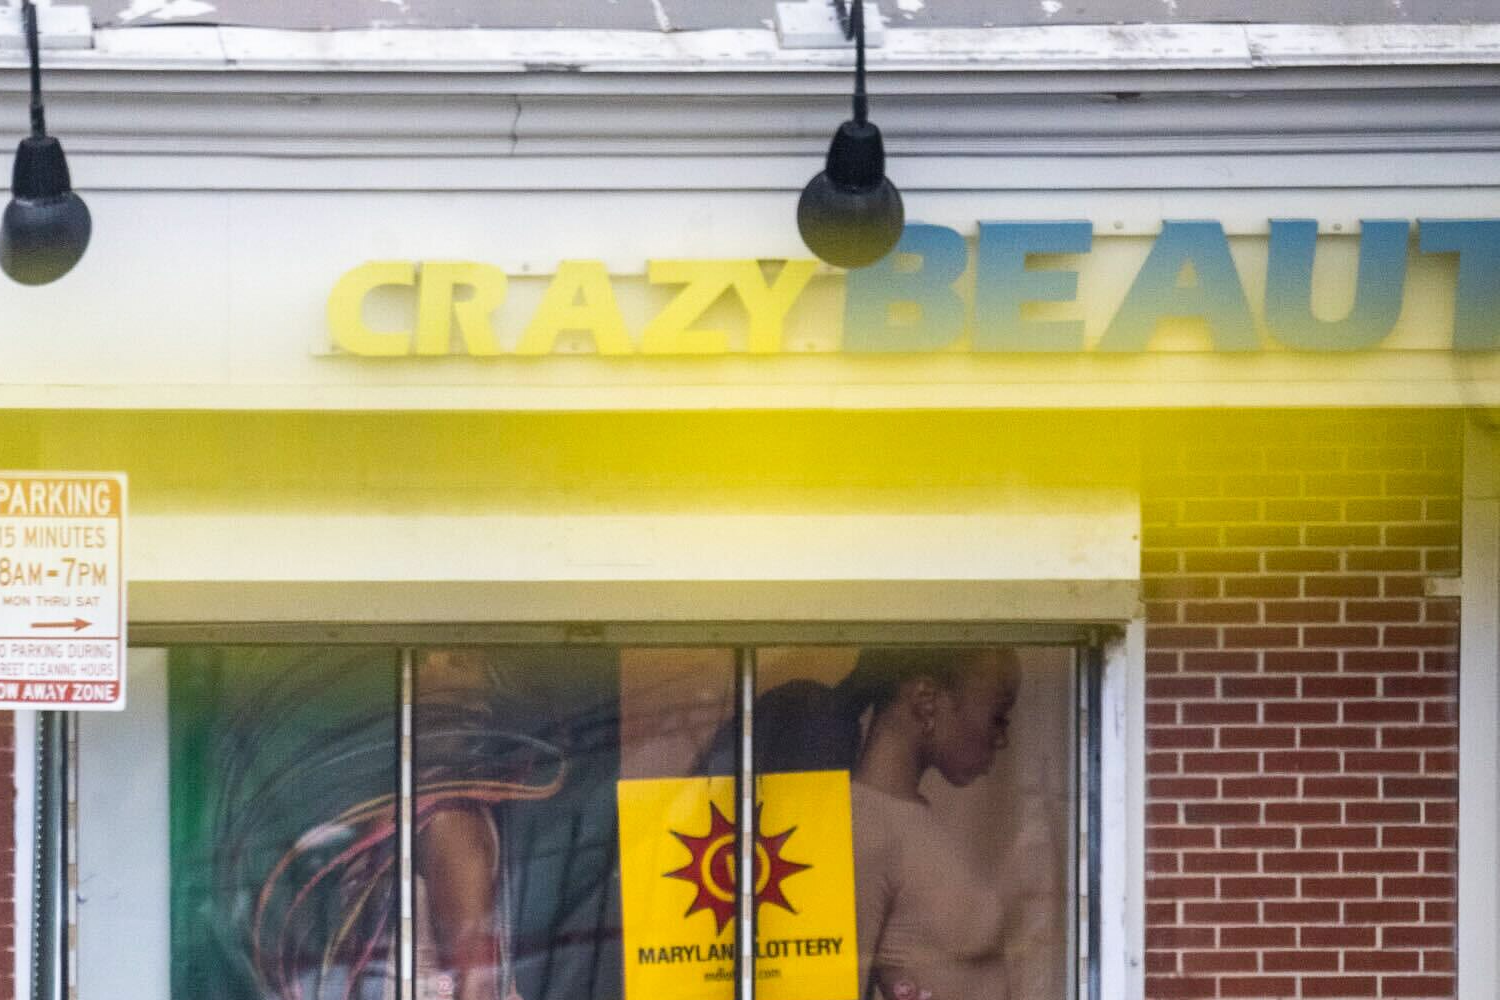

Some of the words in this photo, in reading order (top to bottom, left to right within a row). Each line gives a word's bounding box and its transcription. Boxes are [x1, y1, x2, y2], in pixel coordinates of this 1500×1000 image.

[324, 258, 820, 357] CRAZY
[24, 526, 107, 549] MINUTES
[3, 595, 31, 607] MON
[36, 595, 70, 607] THRU
[76, 595, 100, 607] SAT
[10, 643, 63, 658] PARKING
[67, 643, 112, 658] DURING
[28, 662, 78, 676] CLEANING
[80, 662, 114, 676] HOURS
[23, 683, 68, 700] AWAY
[71, 683, 116, 702] ZONE
[638, 944, 735, 964] MARYLAN
[756, 937, 843, 959] LOTTERY
